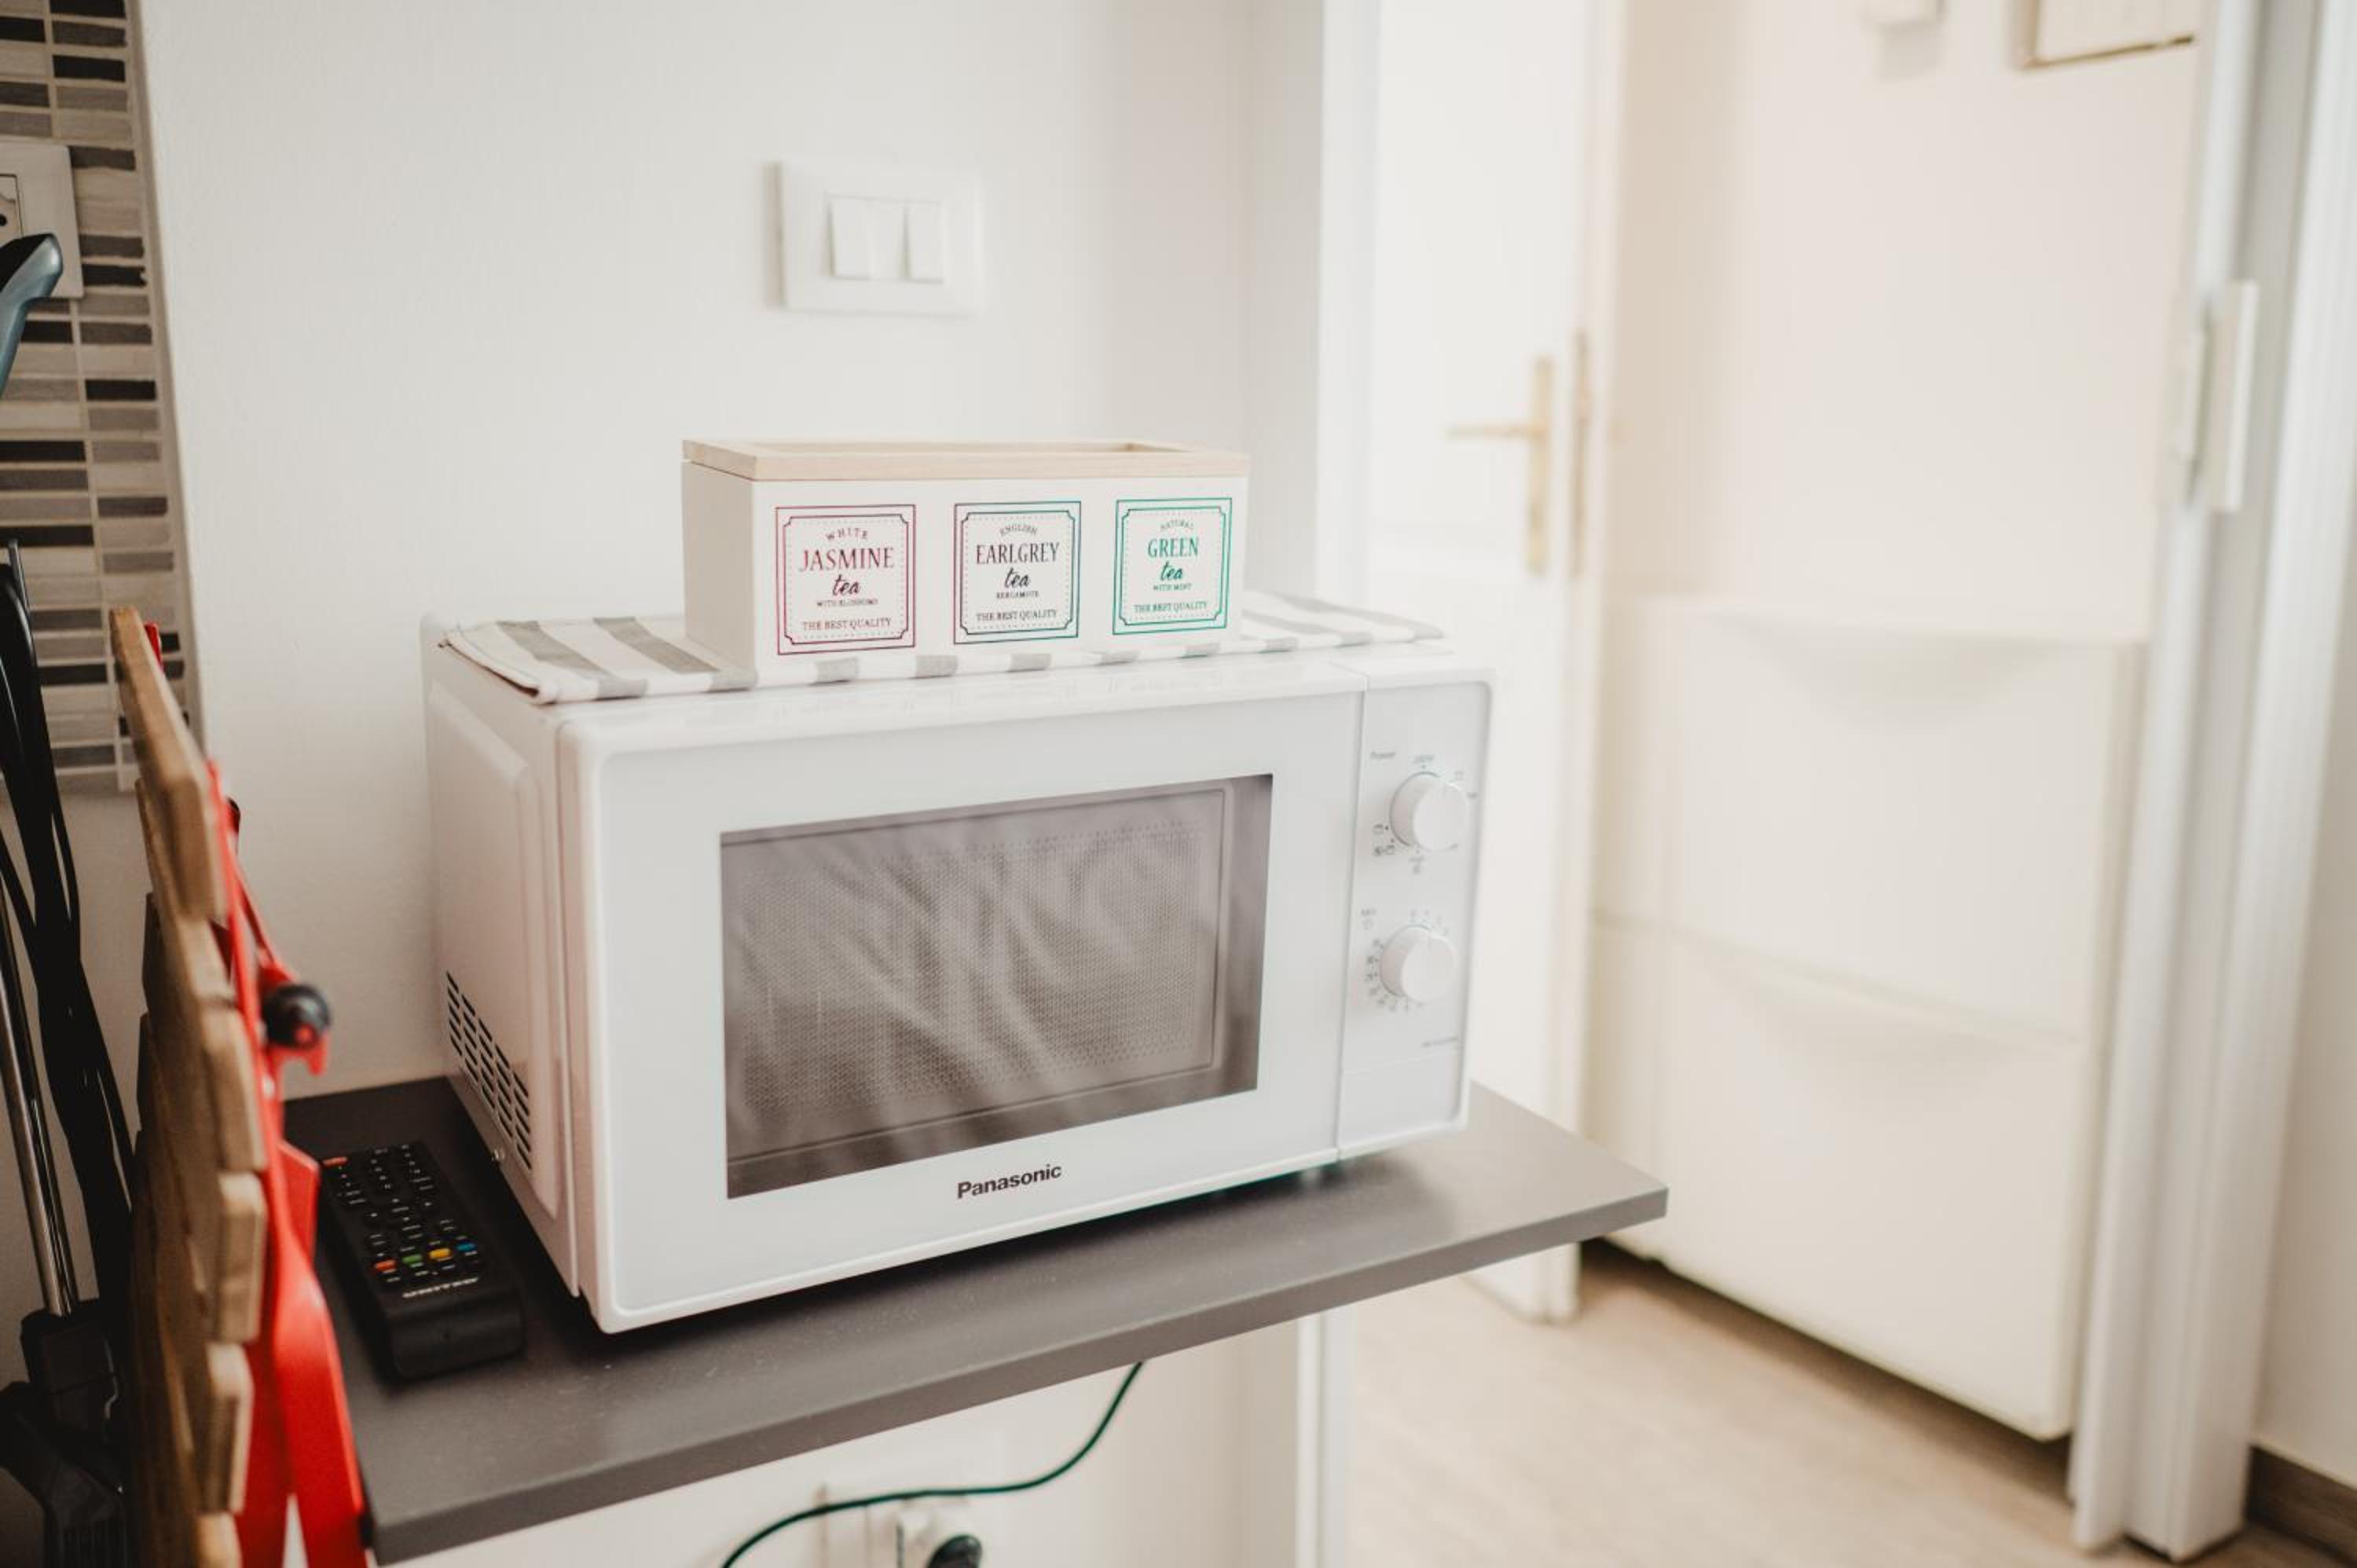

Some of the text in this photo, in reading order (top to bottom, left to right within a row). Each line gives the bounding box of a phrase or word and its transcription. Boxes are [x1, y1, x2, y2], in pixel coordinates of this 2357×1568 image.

[826, 527, 868, 540] WHITE
[976, 542, 1060, 565] EARLGREY
[1148, 537, 1200, 558] GREEN
[799, 547, 894, 572] JASMINE
[1004, 567, 1031, 588] tea
[1160, 561, 1183, 581] tea
[832, 573, 862, 596] tea
[976, 609, 1057, 621] THE BEST QUALITY
[1134, 601, 1208, 613] THE BEST QUALITY
[802, 617, 892, 631] THE BEST QUALITY
[958, 1163, 1062, 1200] Panasonic
